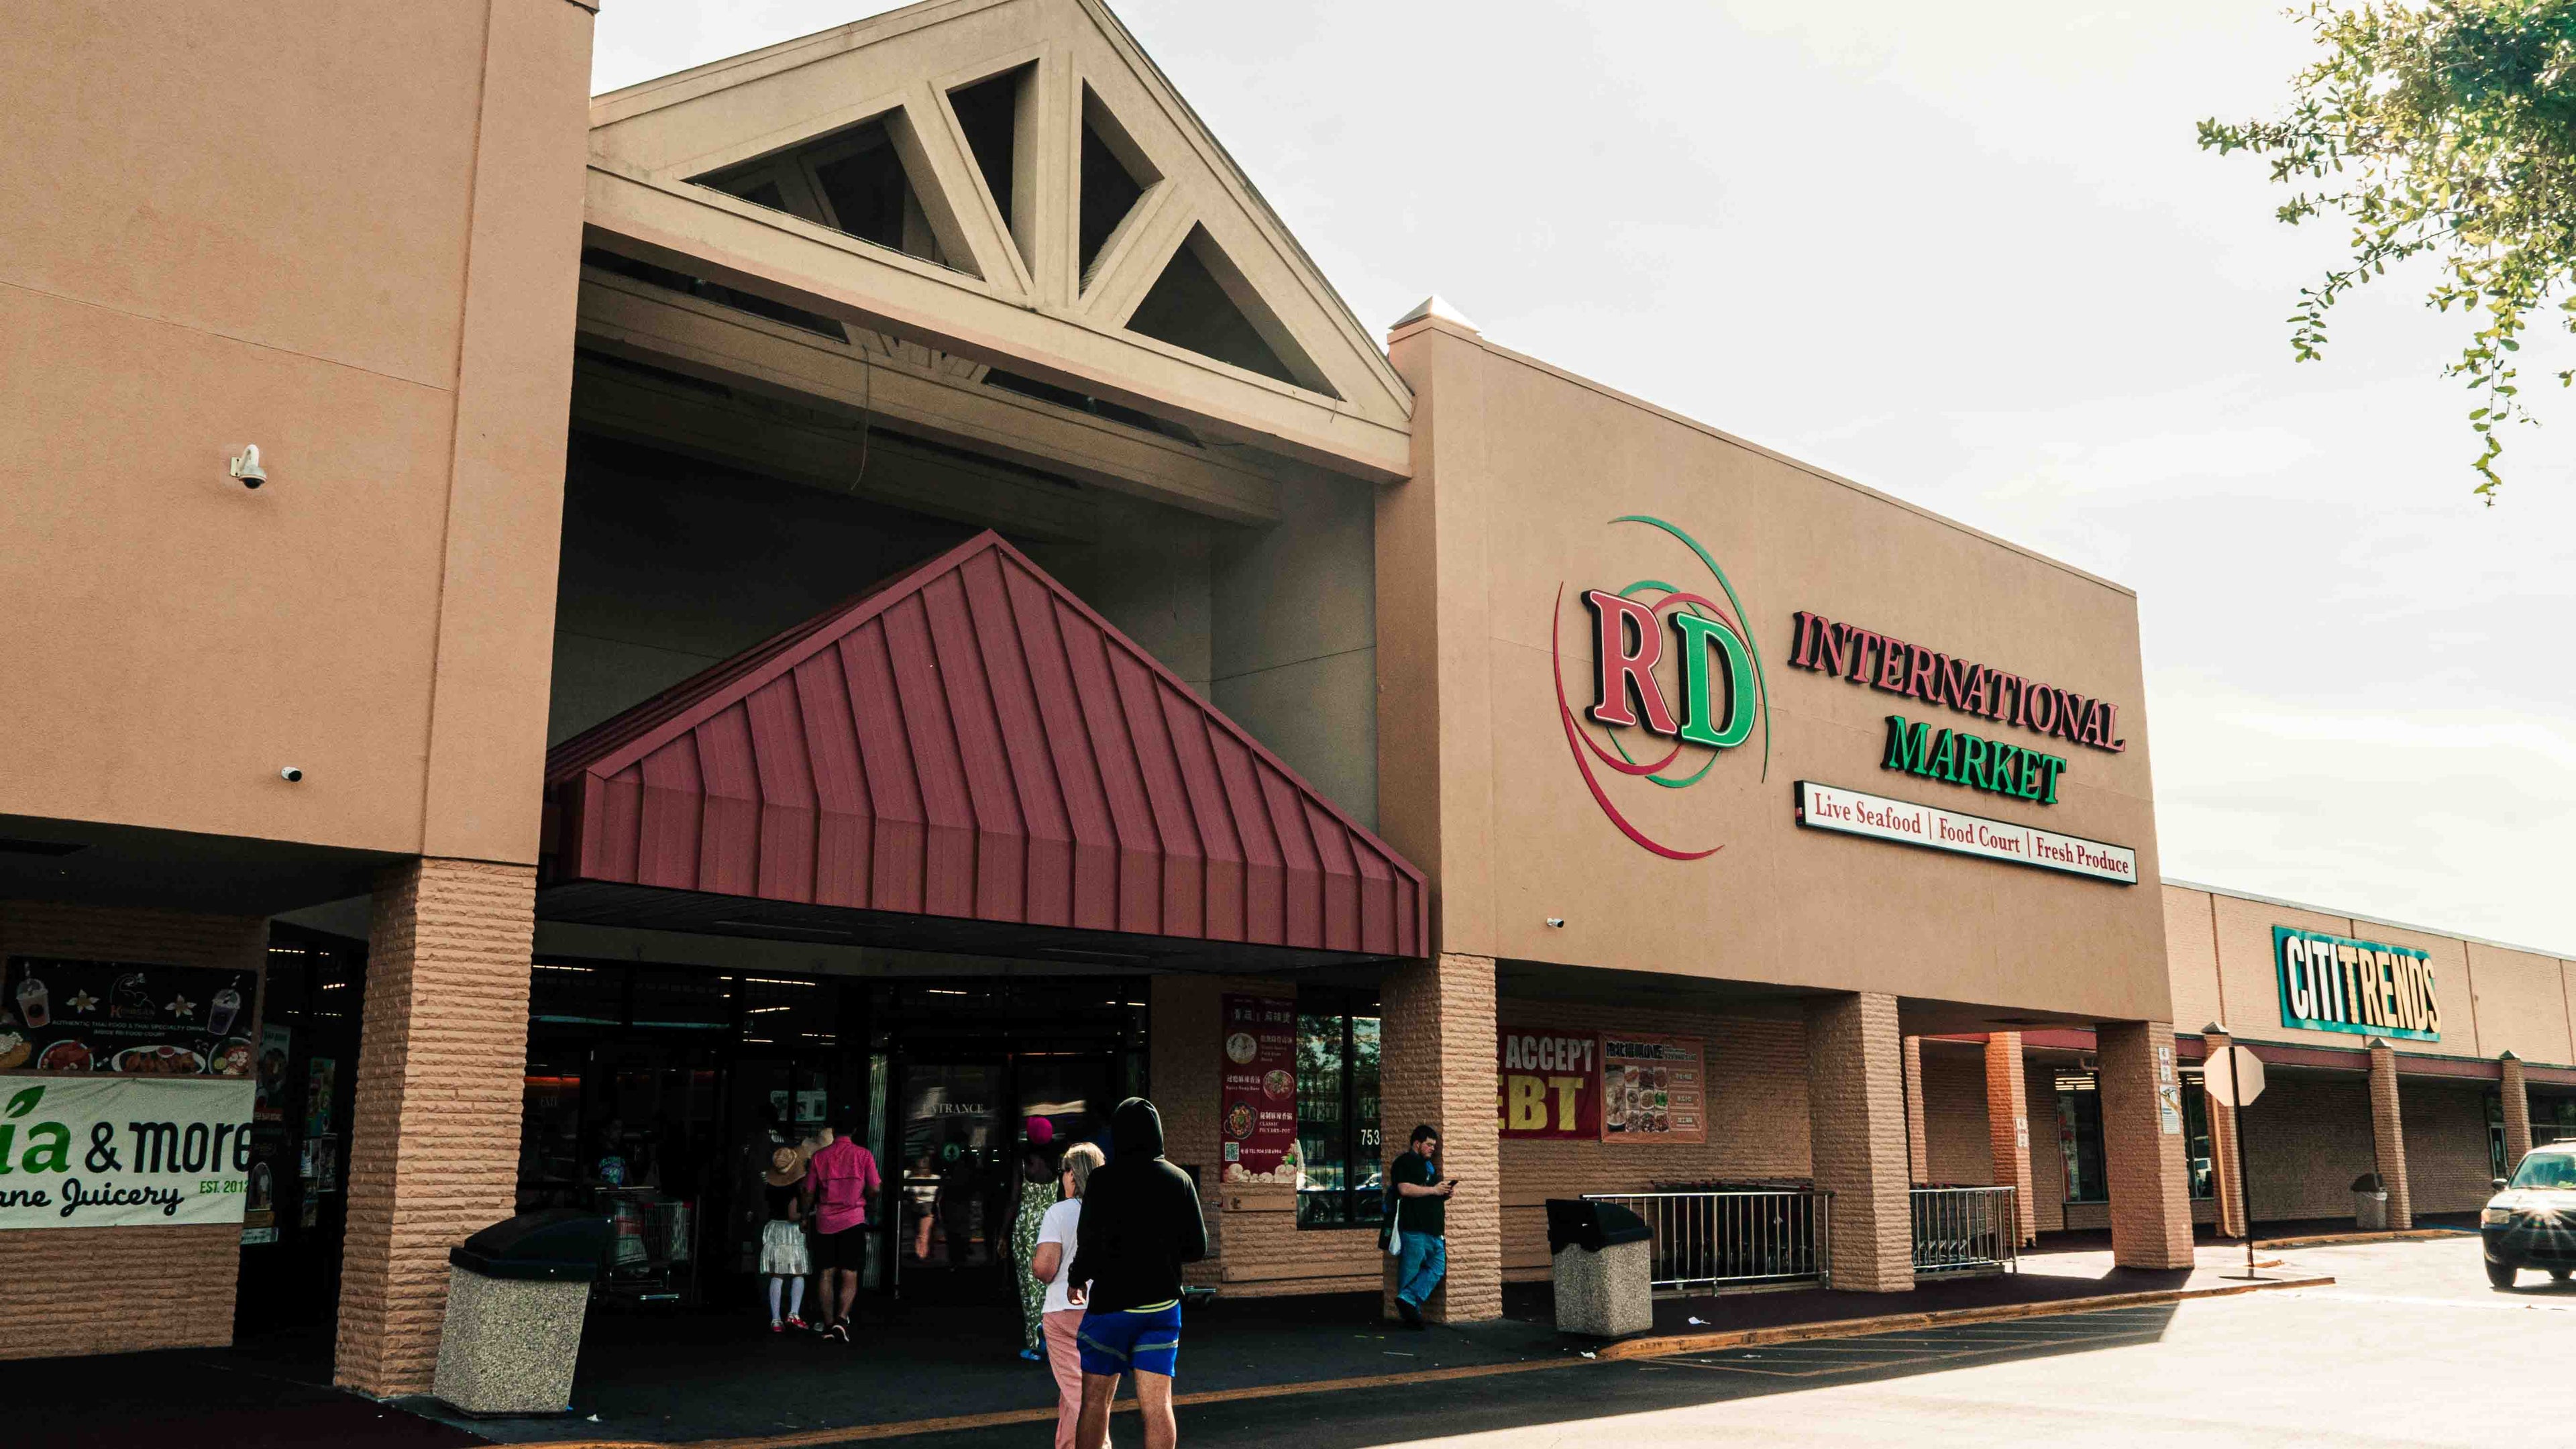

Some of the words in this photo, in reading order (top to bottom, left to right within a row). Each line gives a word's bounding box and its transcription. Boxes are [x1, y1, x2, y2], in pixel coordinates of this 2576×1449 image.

[1581, 589, 1756, 748] RD
[1788, 611, 2125, 752] INTERNATIONAL
[1880, 715, 2067, 804] MARKET
[1815, 792, 1851, 820] Live
[1857, 800, 1922, 834] Seafood
[1939, 817, 1974, 844] Food
[1978, 826, 2021, 853] Court
[2036, 837, 2074, 863] Fresh
[2076, 845, 2129, 873] Produce
[1505, 1034, 1595, 1072] ACCEPT
[85, 1122, 122, 1173] &
[129, 1122, 252, 1173] more
[1361, 1129, 1380, 1146] 753
[60, 1178, 184, 1218] Juicery
[200, 1181, 219, 1193] EST.
